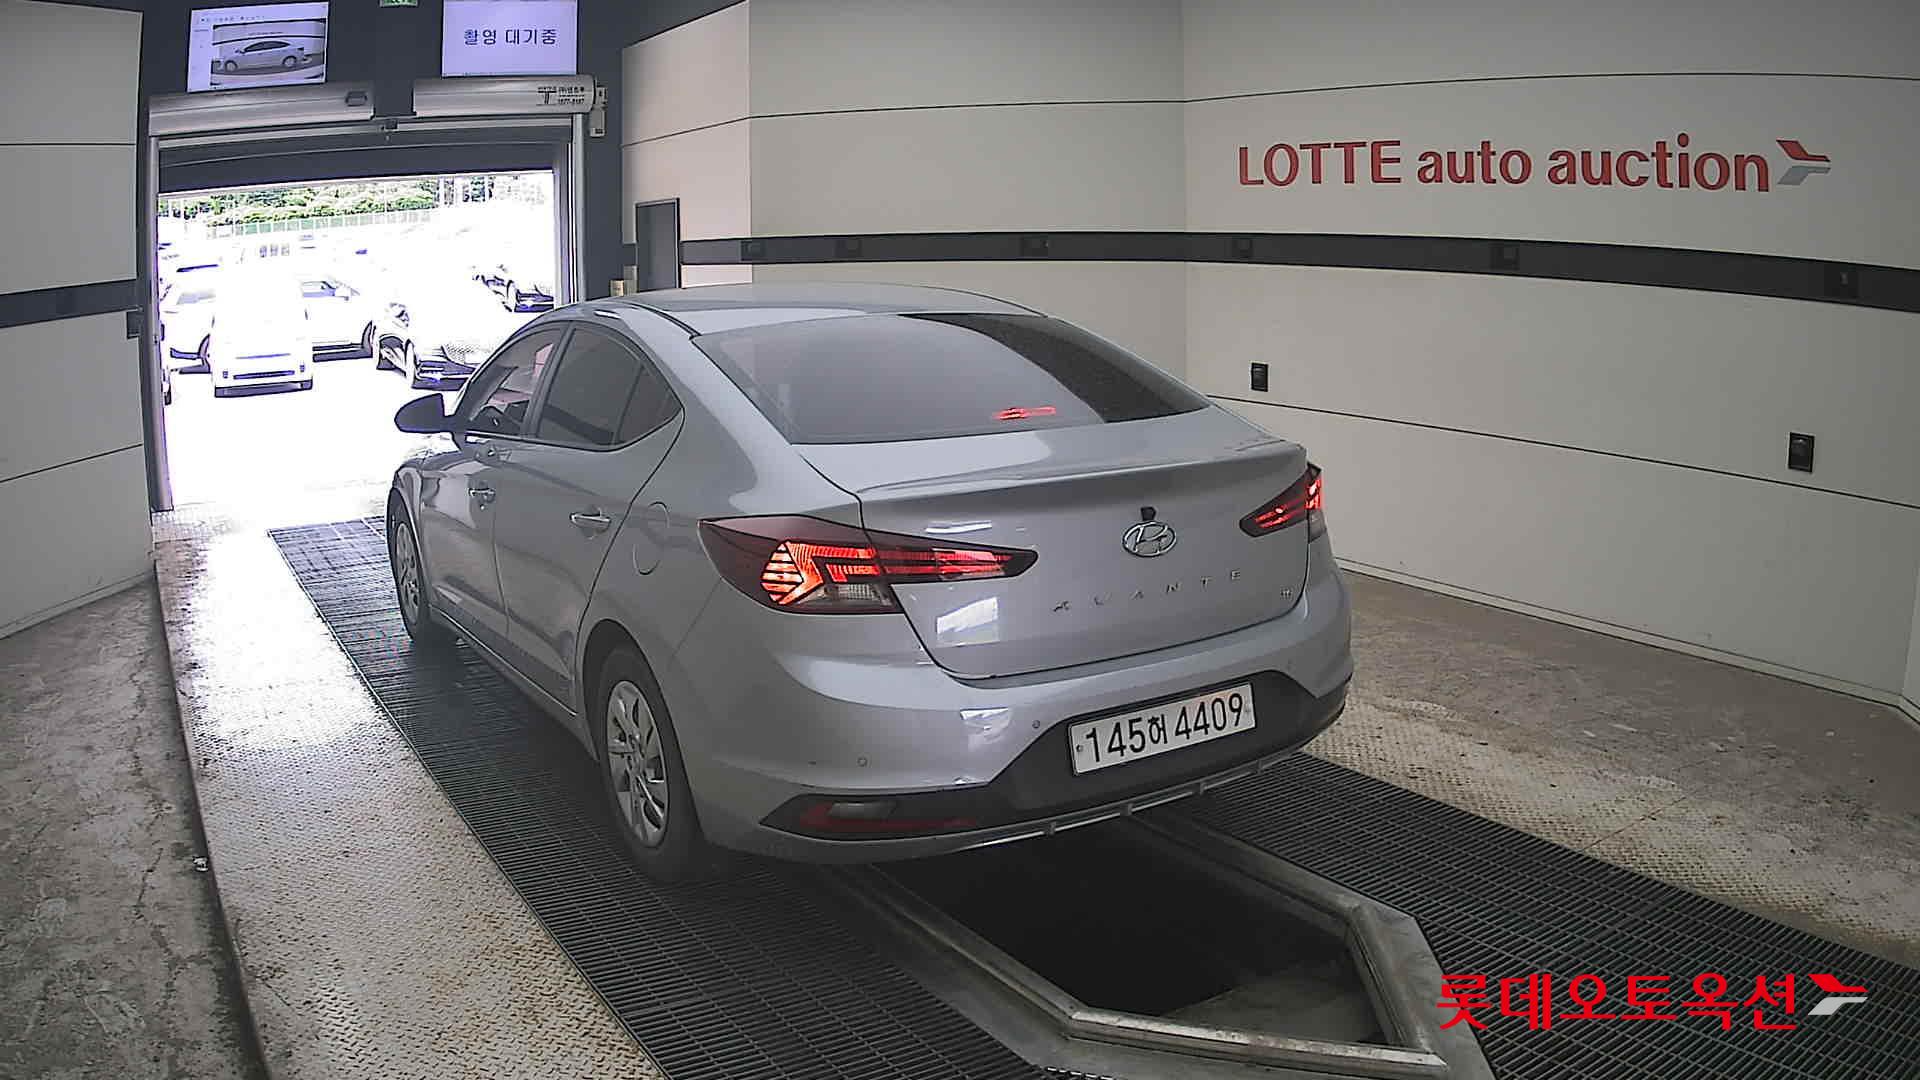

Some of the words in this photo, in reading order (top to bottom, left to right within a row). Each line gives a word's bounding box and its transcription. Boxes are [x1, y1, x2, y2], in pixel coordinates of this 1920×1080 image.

[463, 28, 497, 46] 촬영
[504, 28, 557, 45] 대기중
[1238, 140, 1401, 186] LOTTE
[1417, 140, 1533, 185] auto
[1548, 132, 1770, 193] auction
[1174, 693, 1243, 740] 4409
